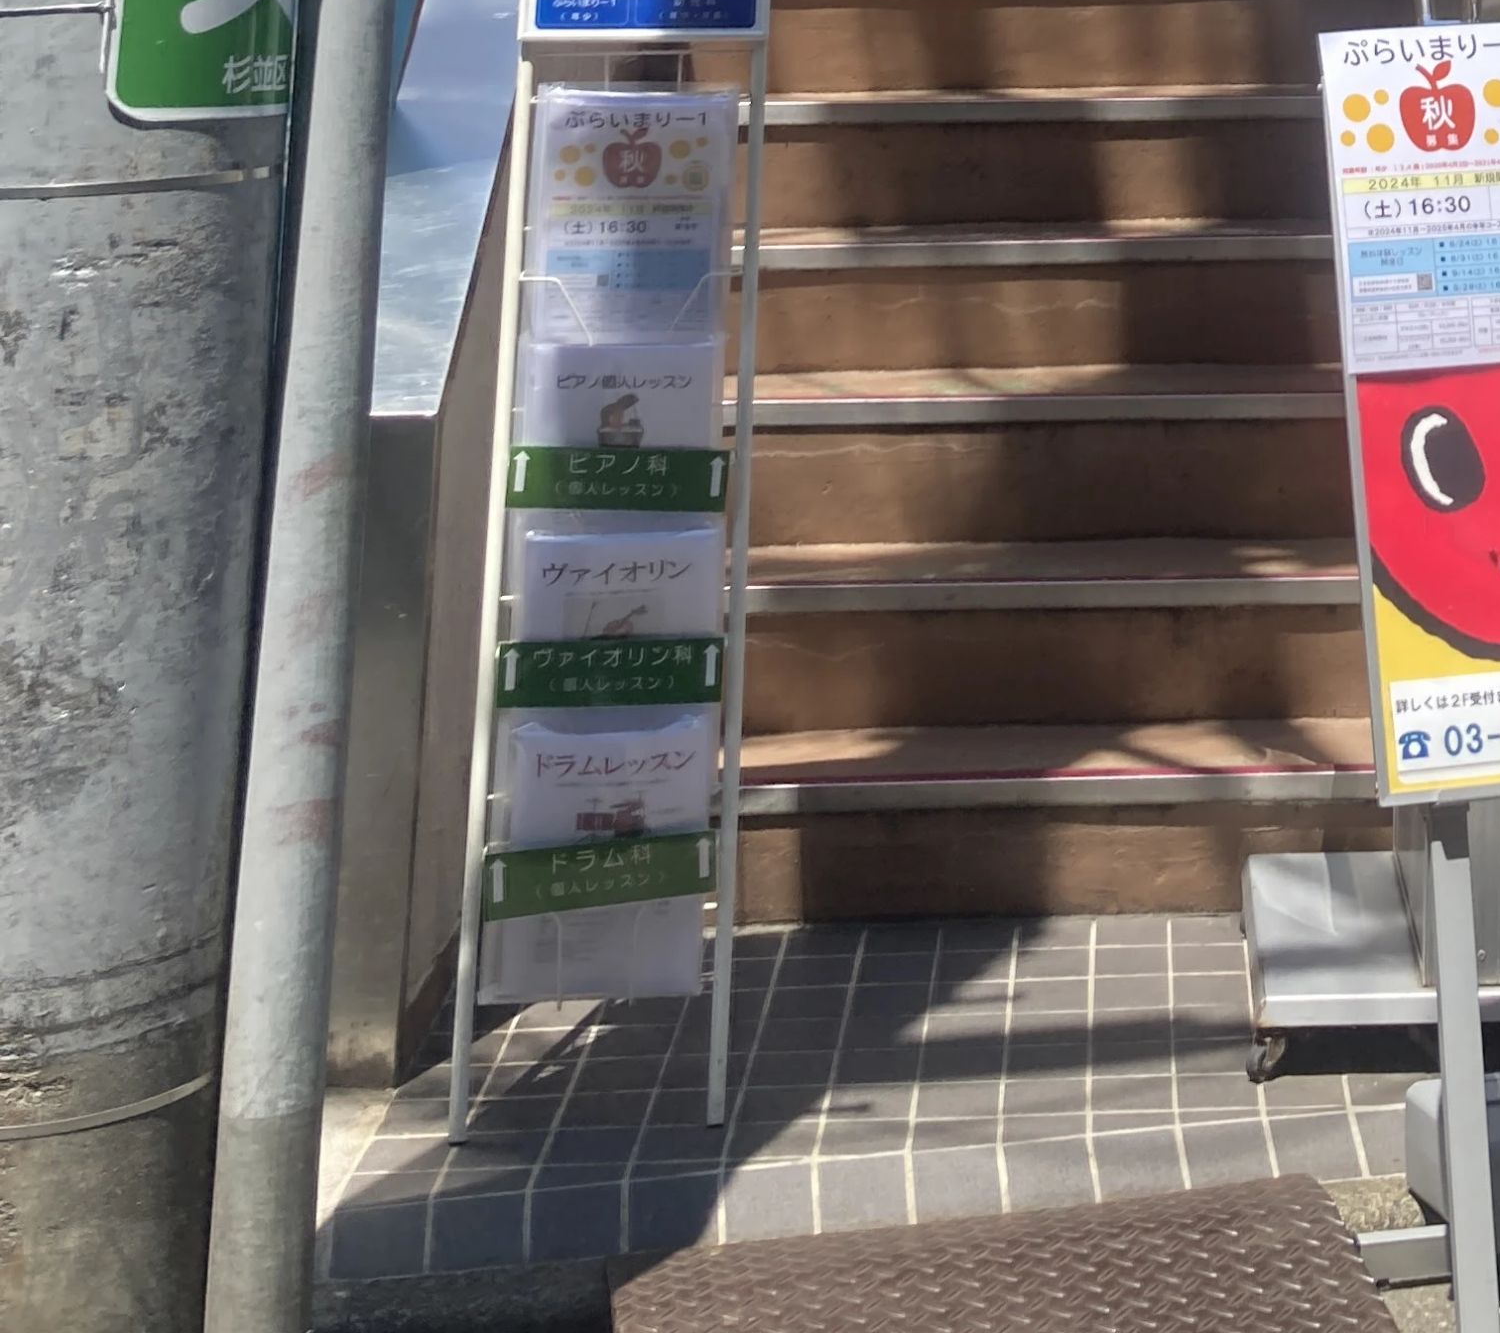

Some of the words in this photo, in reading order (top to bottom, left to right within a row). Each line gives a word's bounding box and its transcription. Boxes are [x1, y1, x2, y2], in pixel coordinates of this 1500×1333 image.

[222, 55, 288, 94] 杉並区
[1420, 95, 1456, 130] 秋
[619, 148, 645, 174] 秋
[569, 454, 668, 476] ピアノ科
[542, 559, 693, 586] ヴァイオリン
[533, 644, 693, 669] ヴァイオリン科
[536, 750, 697, 779] ドラムレッスン
[552, 844, 651, 874] ドラム科
